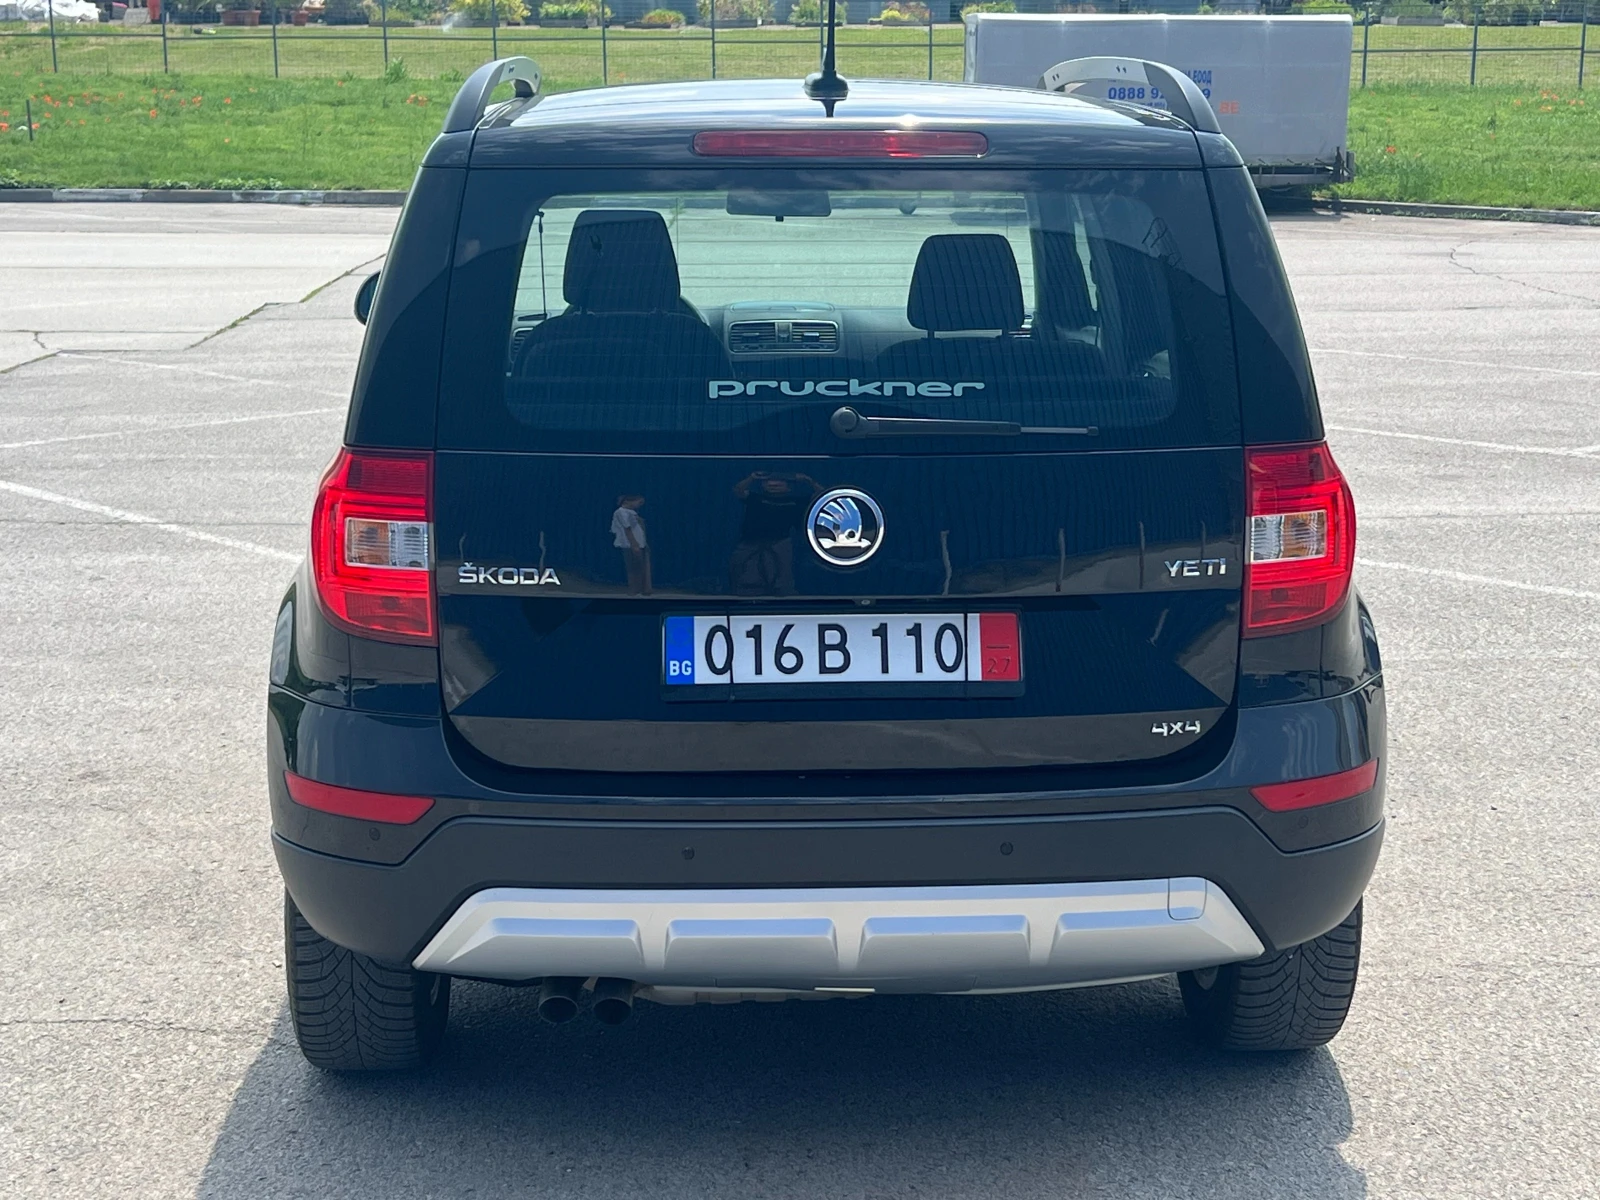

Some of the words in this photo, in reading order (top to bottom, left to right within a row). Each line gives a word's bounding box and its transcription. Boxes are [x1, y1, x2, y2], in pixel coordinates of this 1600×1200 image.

[1108, 87, 1145, 99] 0888
[708, 378, 985, 399] pruckner
[458, 562, 561, 585] ŠKODA
[1164, 557, 1226, 577] YETI
[871, 622, 963, 674] 110
[669, 660, 692, 676] BG
[987, 658, 1011, 673] 27
